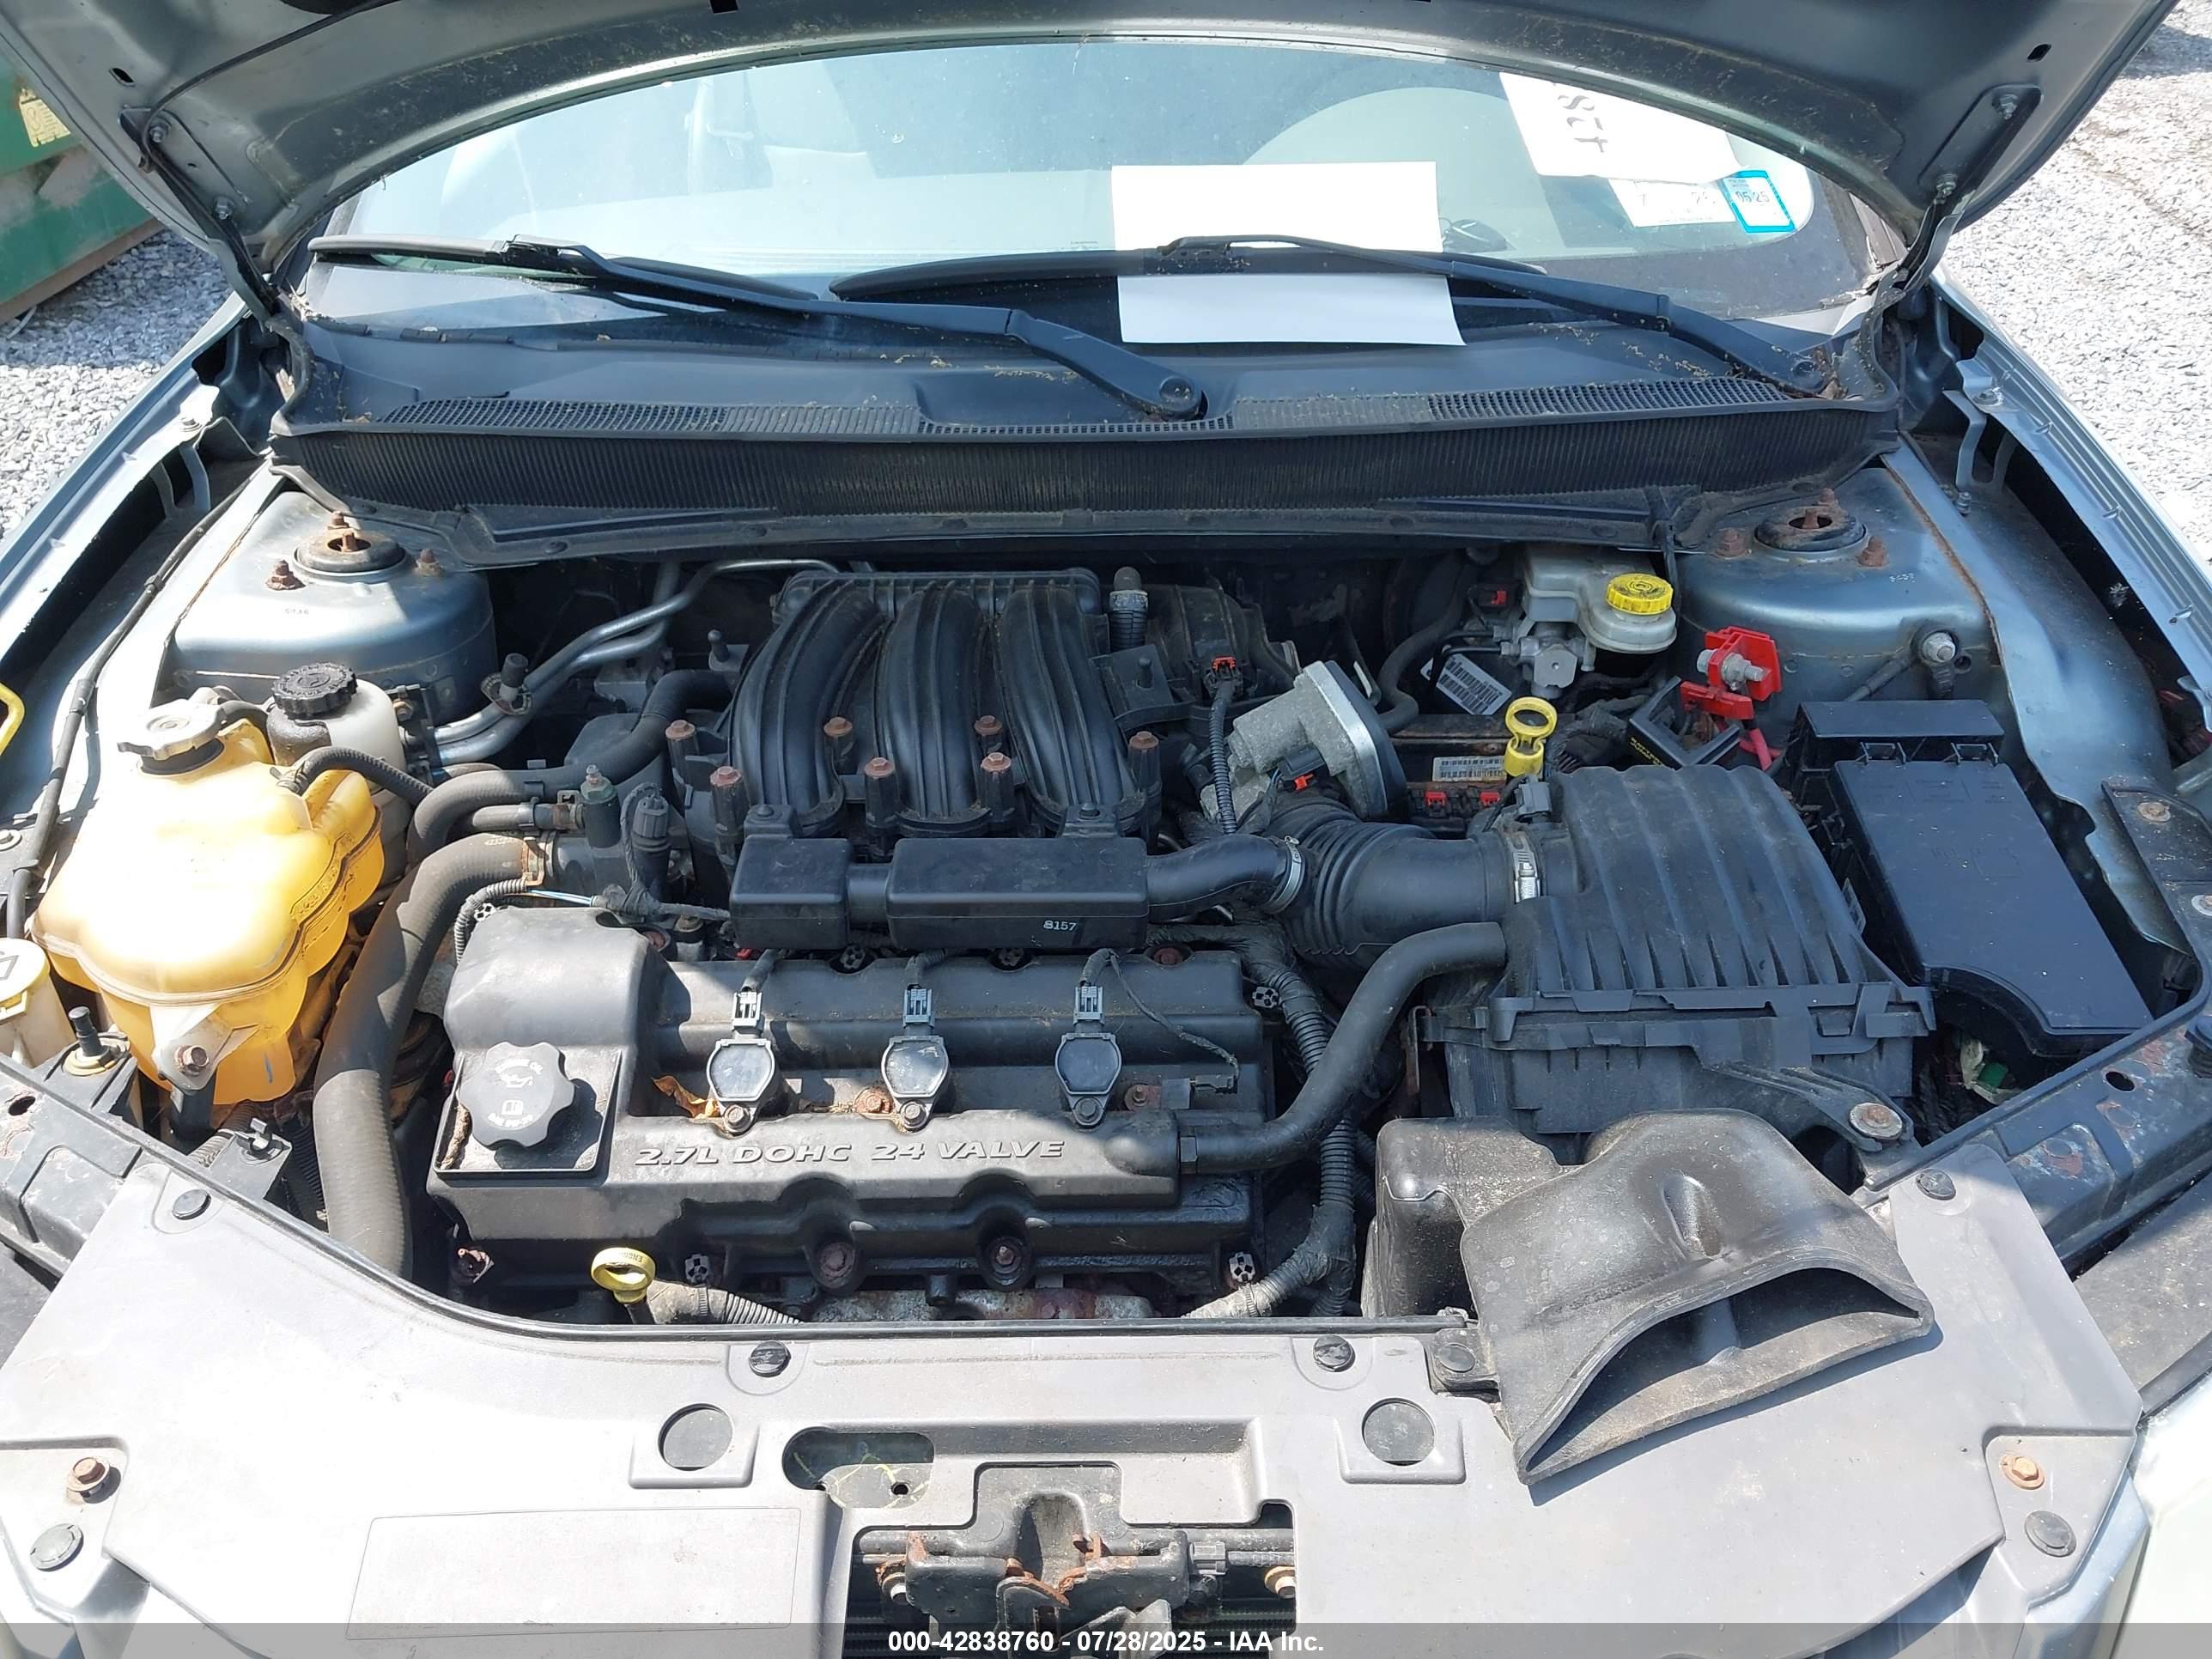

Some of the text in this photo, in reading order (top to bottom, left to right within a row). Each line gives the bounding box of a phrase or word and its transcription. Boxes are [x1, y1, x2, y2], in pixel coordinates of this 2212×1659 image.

[1043, 920, 1077, 931] 8157
[635, 1140, 1065, 1165] 2.7L DOHC 24 VALVE
